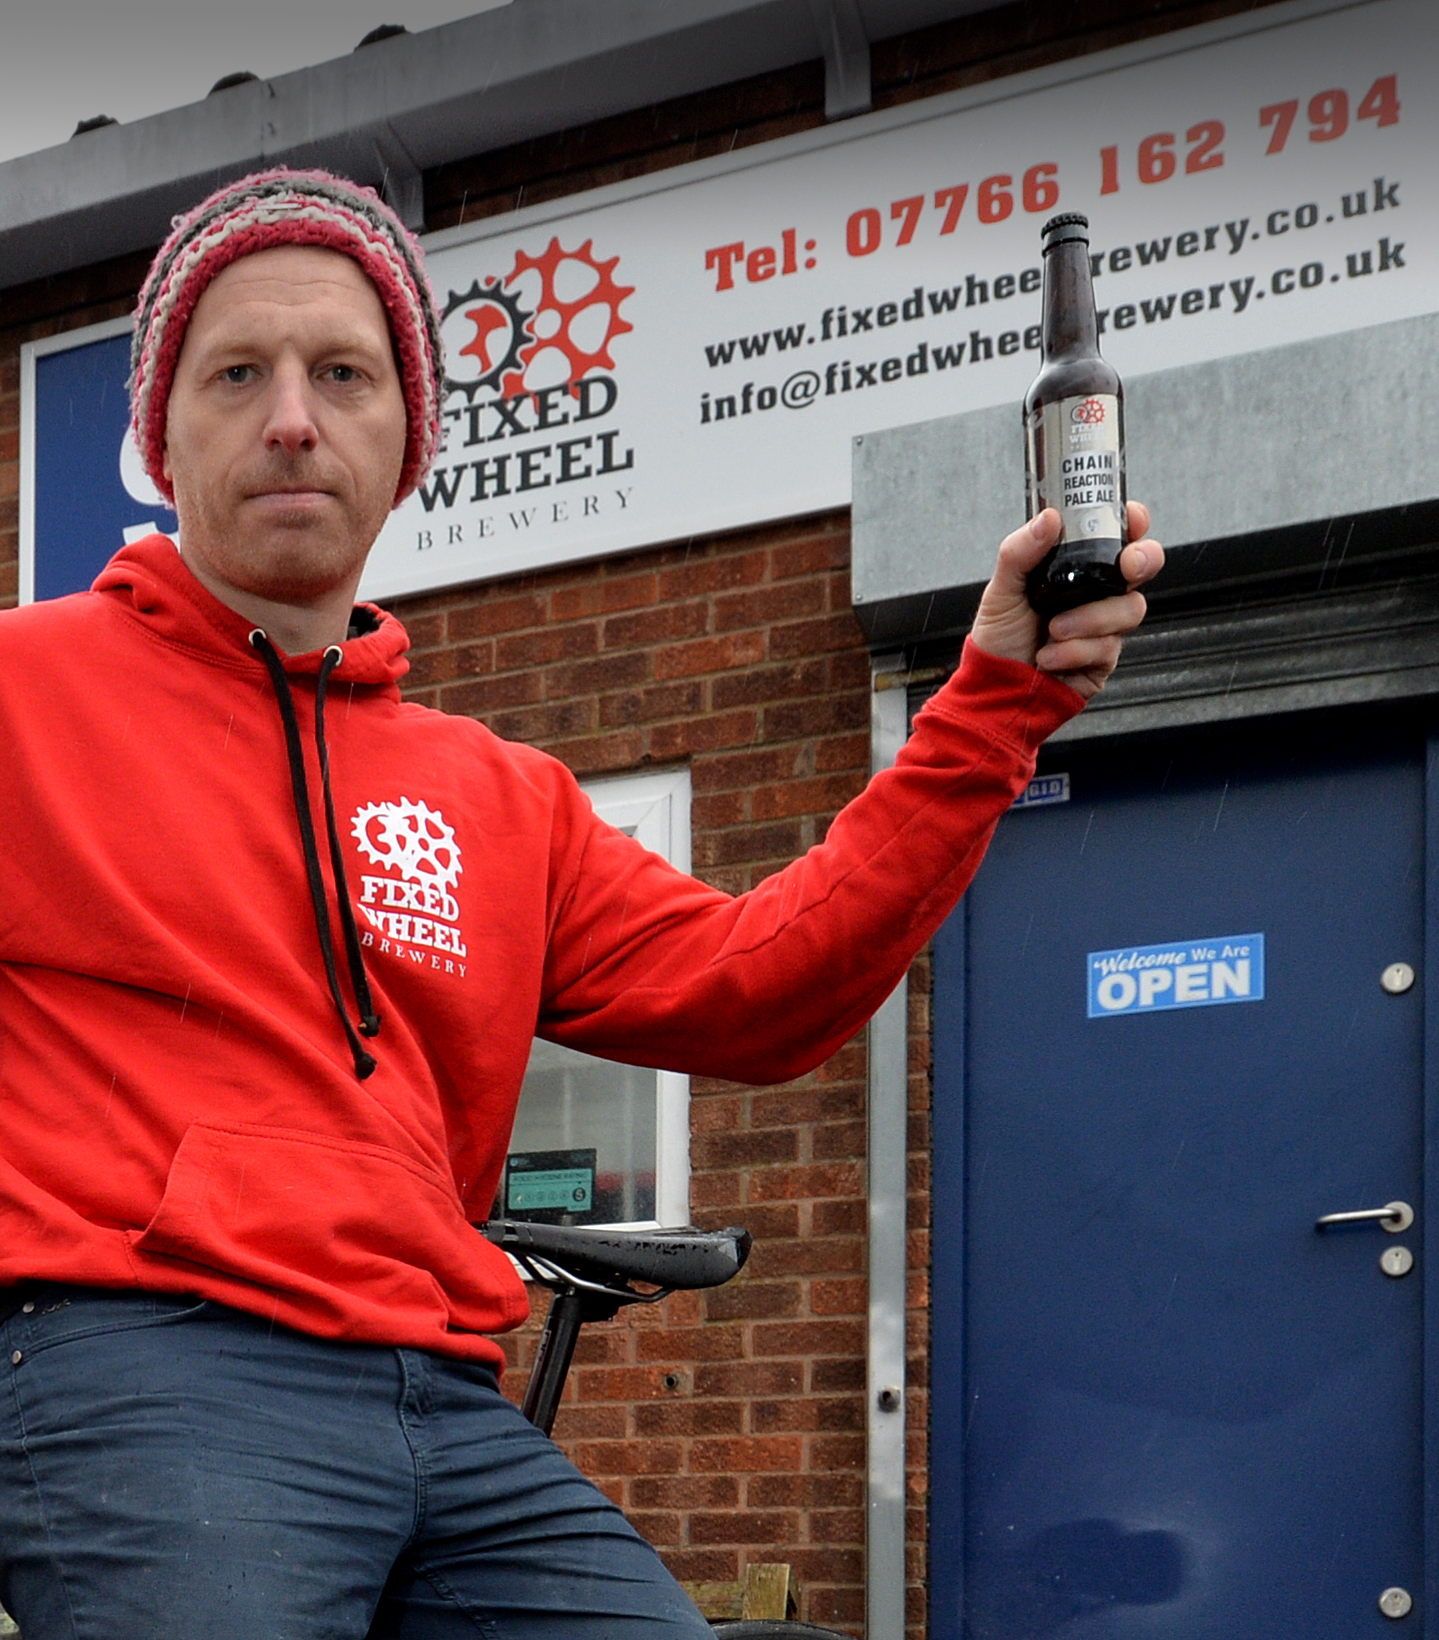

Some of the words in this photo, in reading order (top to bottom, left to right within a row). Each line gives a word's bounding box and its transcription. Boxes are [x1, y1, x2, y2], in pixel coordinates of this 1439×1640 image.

[705, 229, 817, 292] Tel:
[846, 163, 1060, 258] 07766
[1099, 120, 1225, 195] 162
[1260, 74, 1402, 156] 794
[705, 176, 1402, 369] www.fixedwheerewery.co.uk
[700, 236, 1407, 426] info@fixedwheerewery.co.uk
[437, 374, 619, 454] FIXED
[418, 430, 635, 513] WHEEL
[1062, 455, 1113, 473] CHAIN
[1064, 473, 1114, 491] REACTION
[417, 487, 635, 552] BREWERY
[1064, 491, 1093, 508] PALE
[1095, 489, 1114, 503] ALE
[360, 874, 460, 922] FIXED
[356, 902, 467, 958] WHEEL
[361, 931, 467, 978] BREWERY
[1093, 950, 1187, 975] Welcome
[1191, 946, 1218, 962] We
[1221, 944, 1251, 960] Are
[1096, 959, 1251, 1011] OPEN
